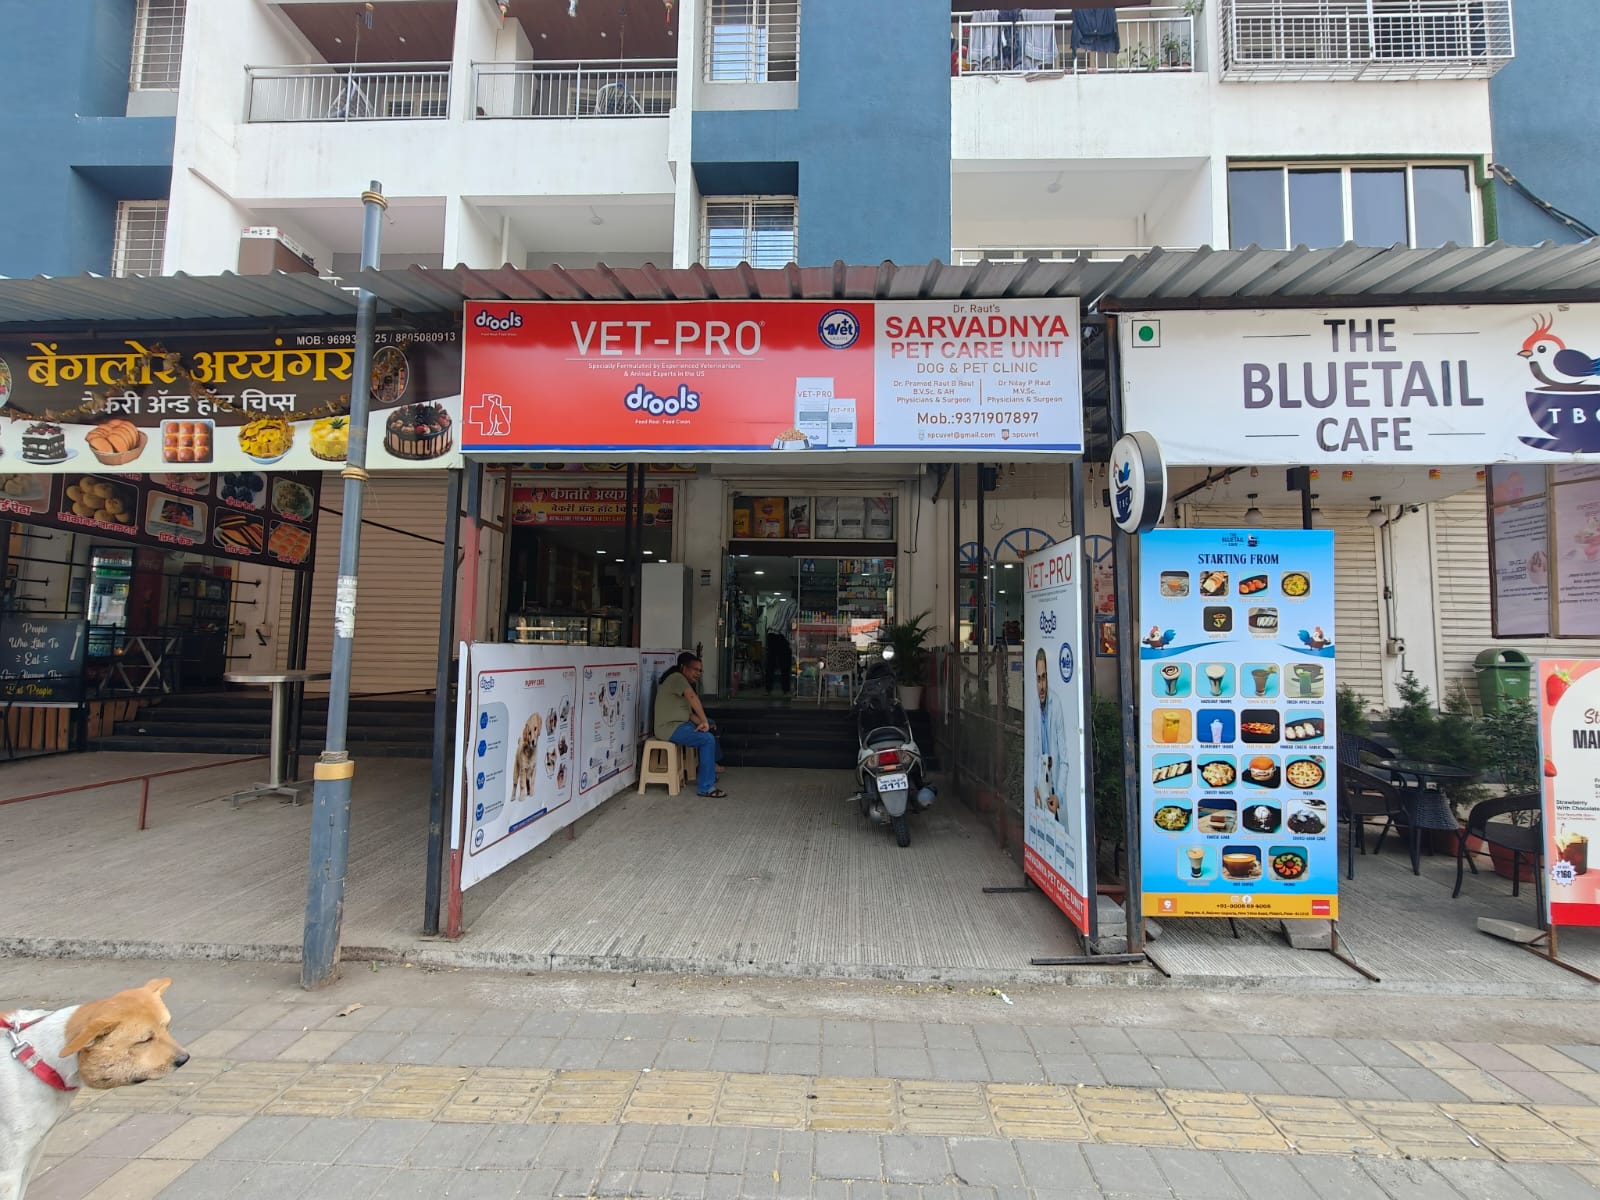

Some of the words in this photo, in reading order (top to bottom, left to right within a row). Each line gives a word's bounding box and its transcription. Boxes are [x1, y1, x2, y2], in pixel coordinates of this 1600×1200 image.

[953, 304, 966, 313] Dr.
[970, 304, 1000, 313] Raut's
[475, 310, 522, 330] drools
[885, 315, 1069, 338] SARVADNYA
[296, 335, 325, 346] MOB:
[1323, 319, 1396, 353] THE
[891, 342, 934, 359] PET
[941, 342, 1003, 359] CARE
[1011, 341, 1063, 358] UNIT
[27, 341, 177, 388] बेंगलोर
[917, 363, 944, 373] DOG
[949, 363, 958, 373] &
[963, 363, 988, 373] PET
[993, 362, 1038, 373] CLINIC
[1243, 359, 1484, 409] BLUETAIL
[239, 388, 297, 413] चिप्स
[625, 385, 699, 415] drools
[1315, 417, 1414, 453] CAFE
[1198, 553, 1247, 565] STARTING
[1250, 553, 1279, 565] FROM
[1556, 799, 1587, 807] Strawberry
